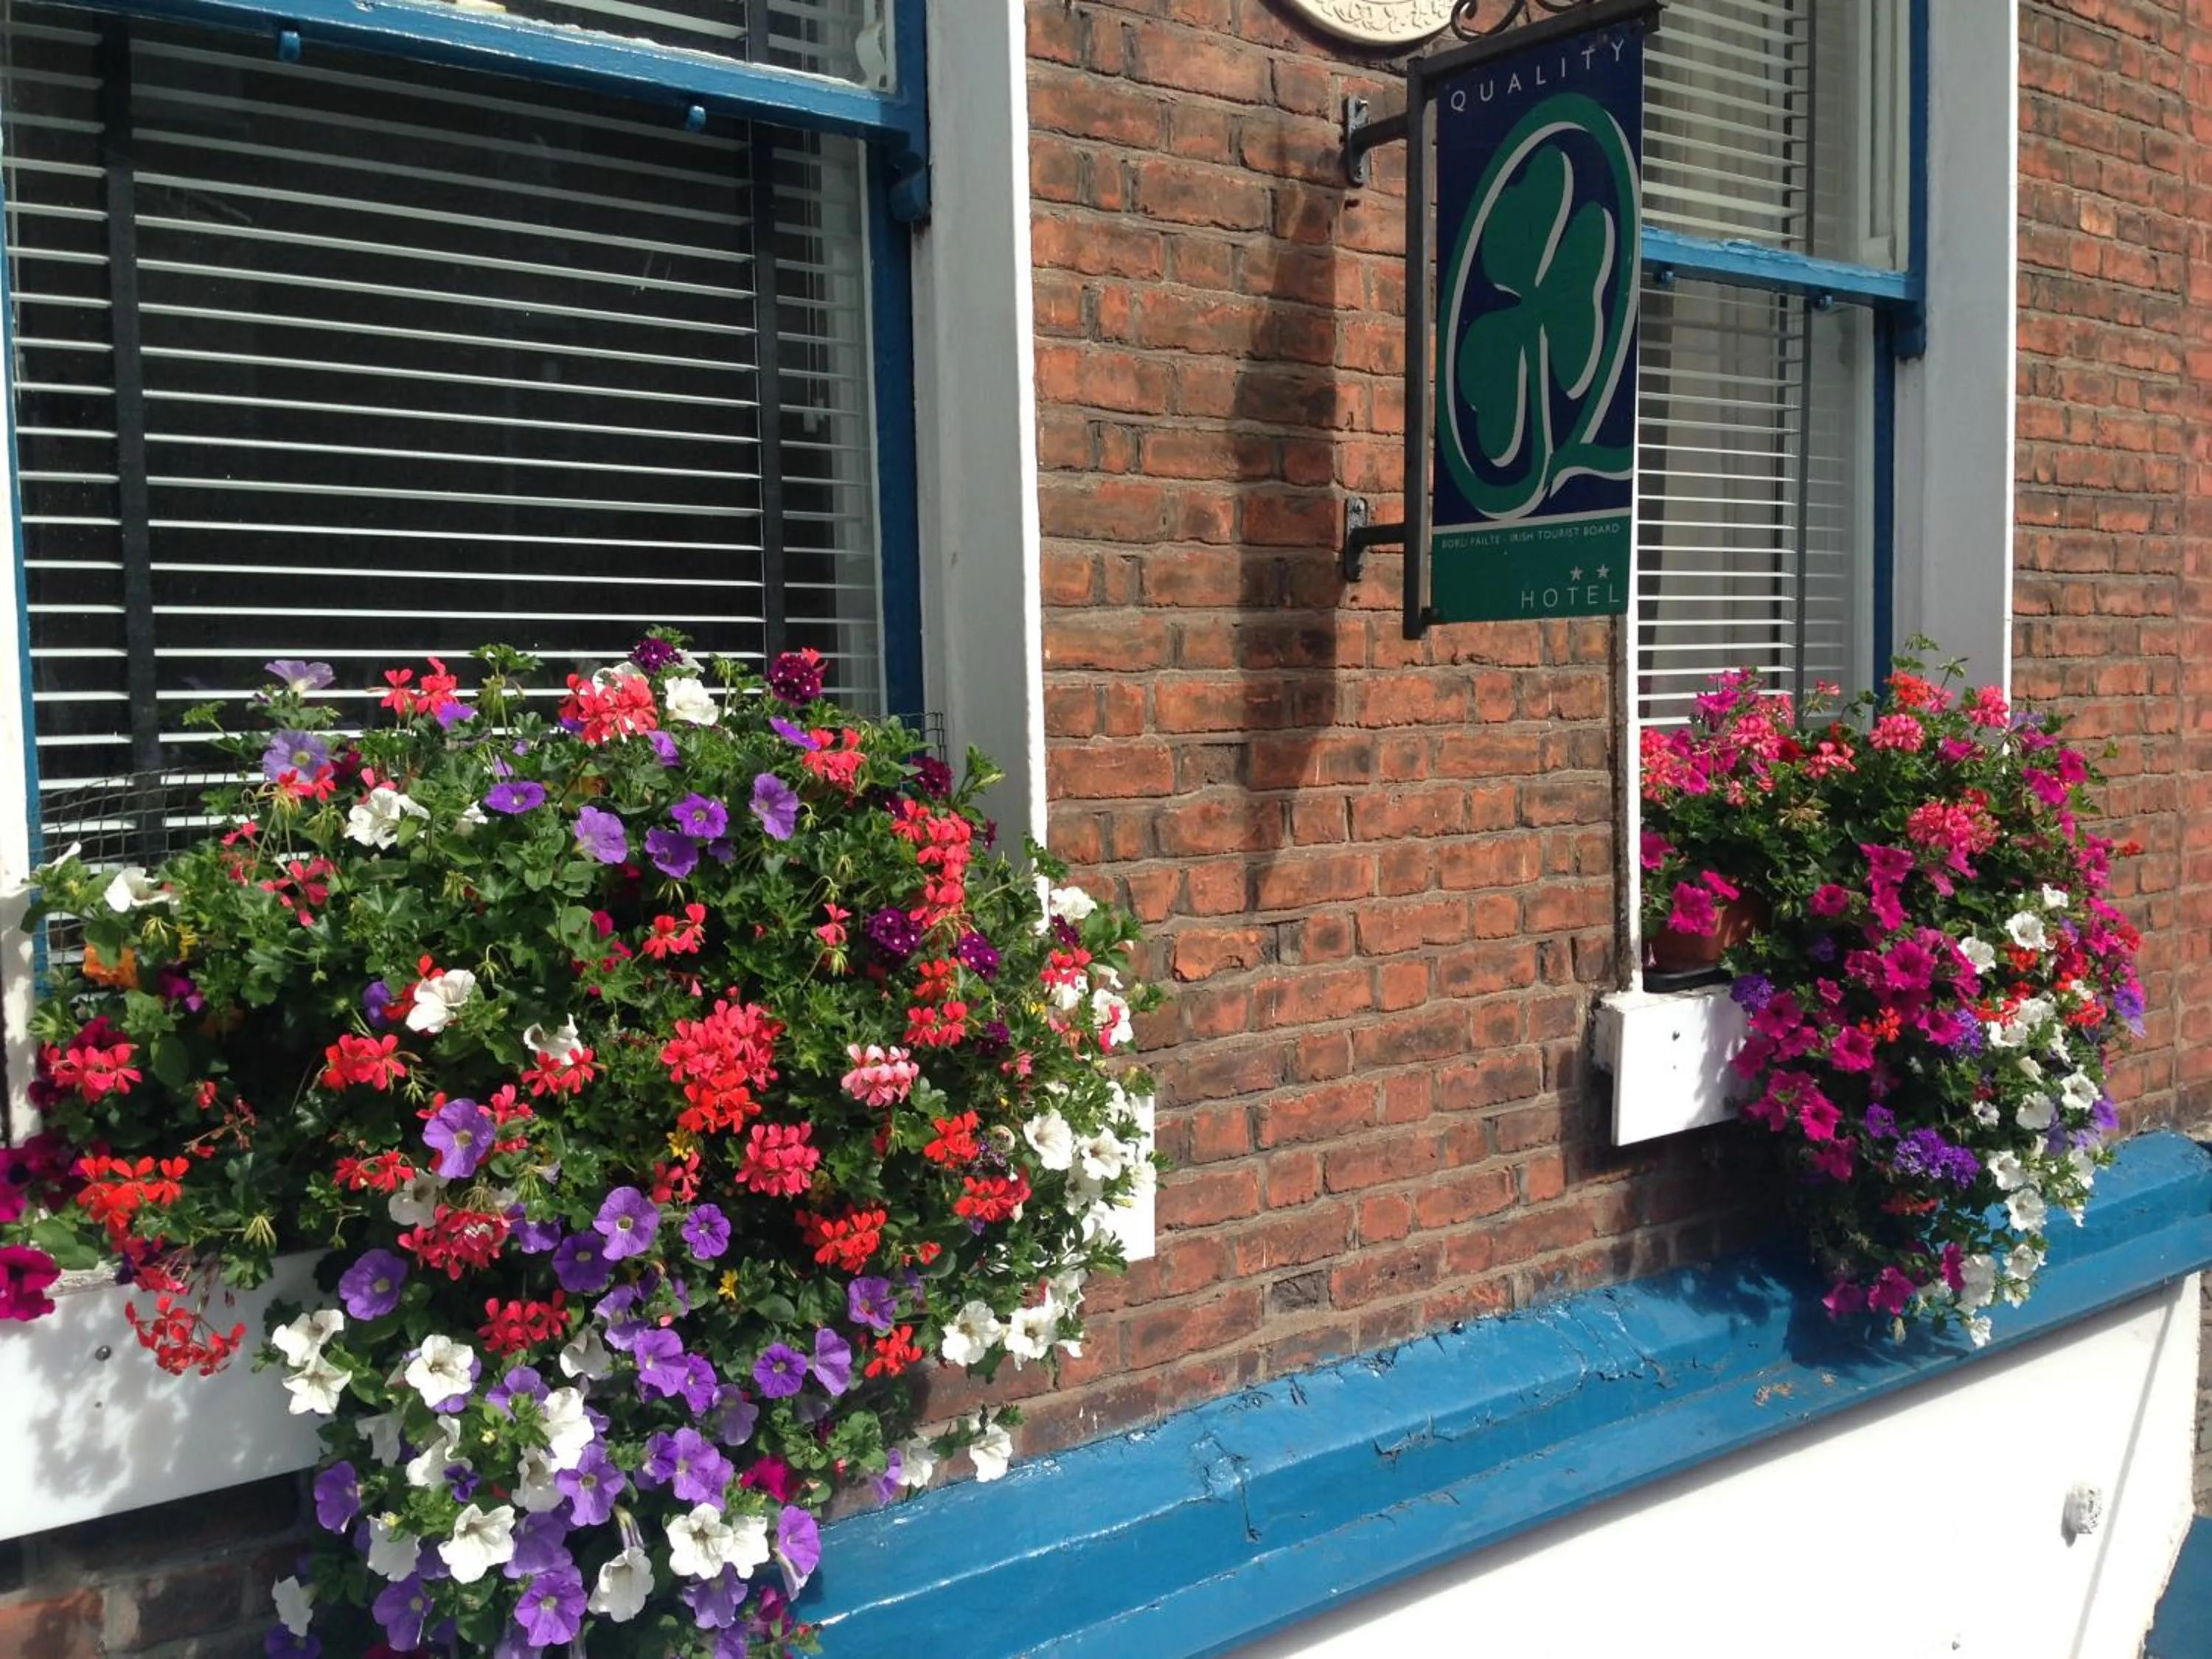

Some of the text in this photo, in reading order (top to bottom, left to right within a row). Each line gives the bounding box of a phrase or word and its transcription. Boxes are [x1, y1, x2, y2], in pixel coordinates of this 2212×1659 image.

[1450, 39, 1624, 111] QUALITY
[1509, 531, 1534, 542] IRISH
[1537, 526, 1580, 540] TOURIST
[1583, 523, 1620, 537] BOARD
[1520, 584, 1621, 609] HOTEL
